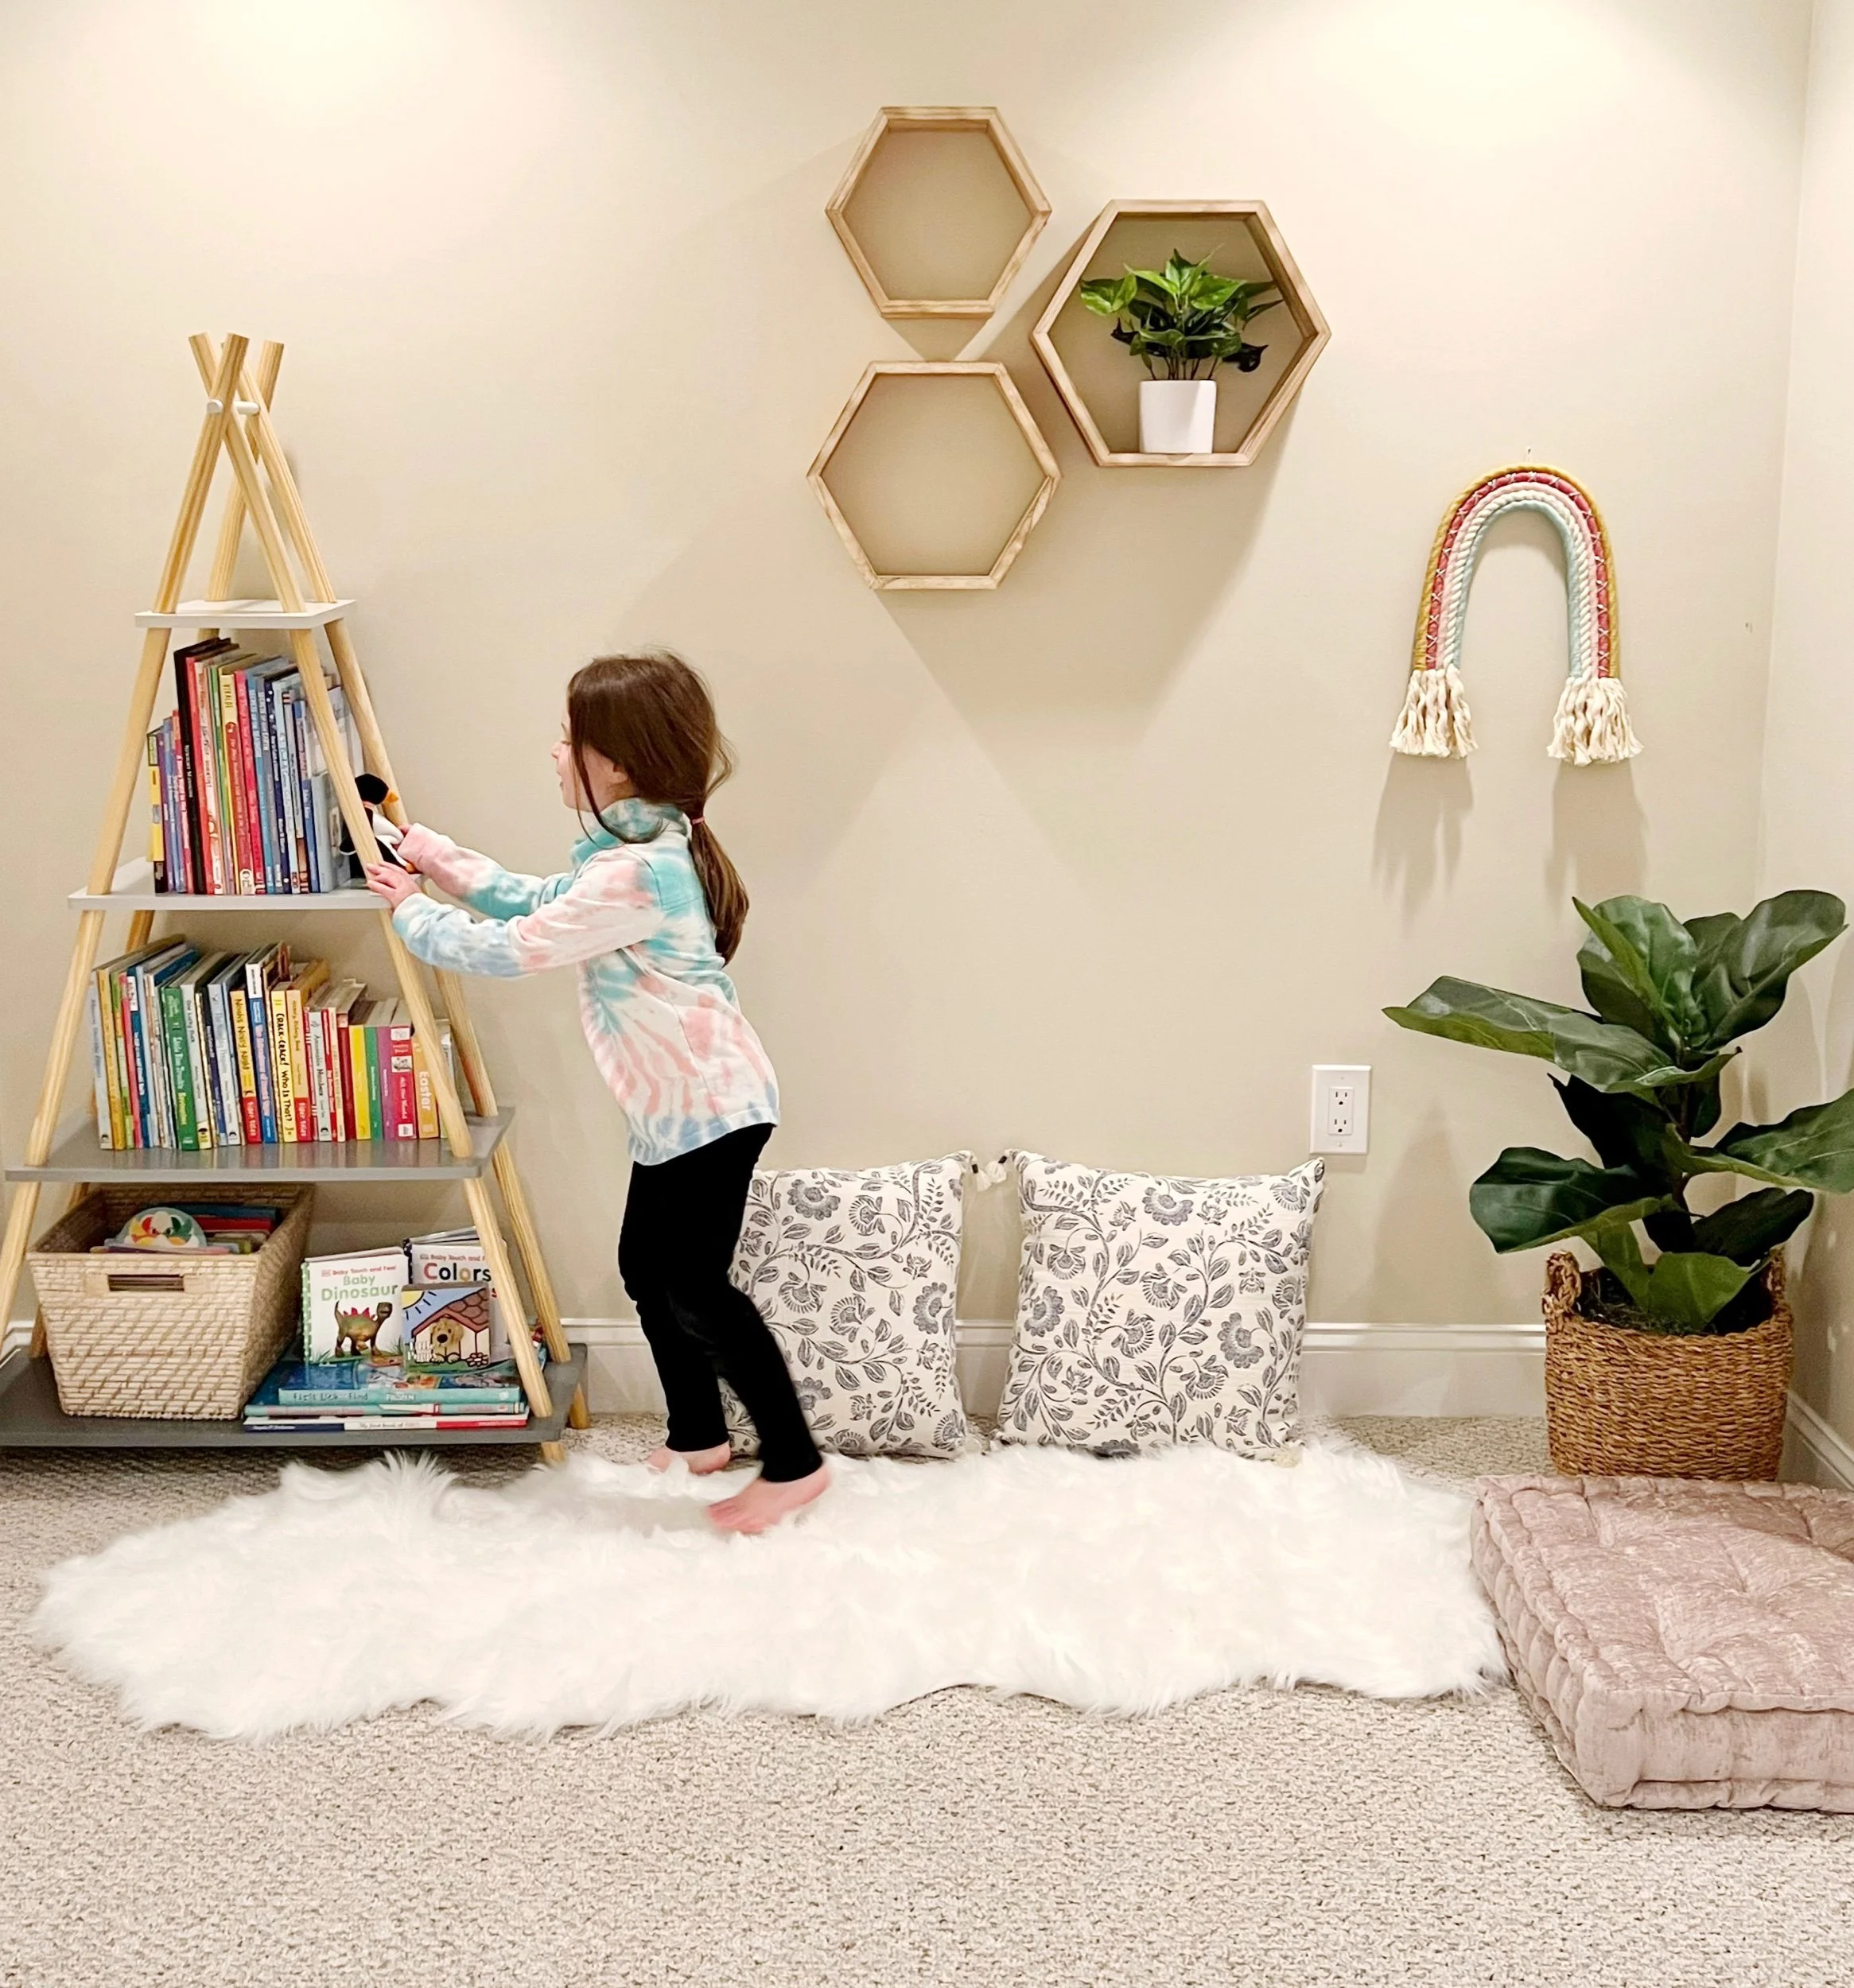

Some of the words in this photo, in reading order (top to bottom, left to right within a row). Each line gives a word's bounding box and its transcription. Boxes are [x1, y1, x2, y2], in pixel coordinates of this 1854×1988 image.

[276, 1013, 290, 1066] CRACK-CRACK!
[284, 1099, 293, 1121] That?
[419, 1071, 432, 1111] Easter
[343, 1275, 375, 1287] Baby
[424, 1263, 492, 1282] Colors
[321, 1284, 398, 1302] Dinosaur
